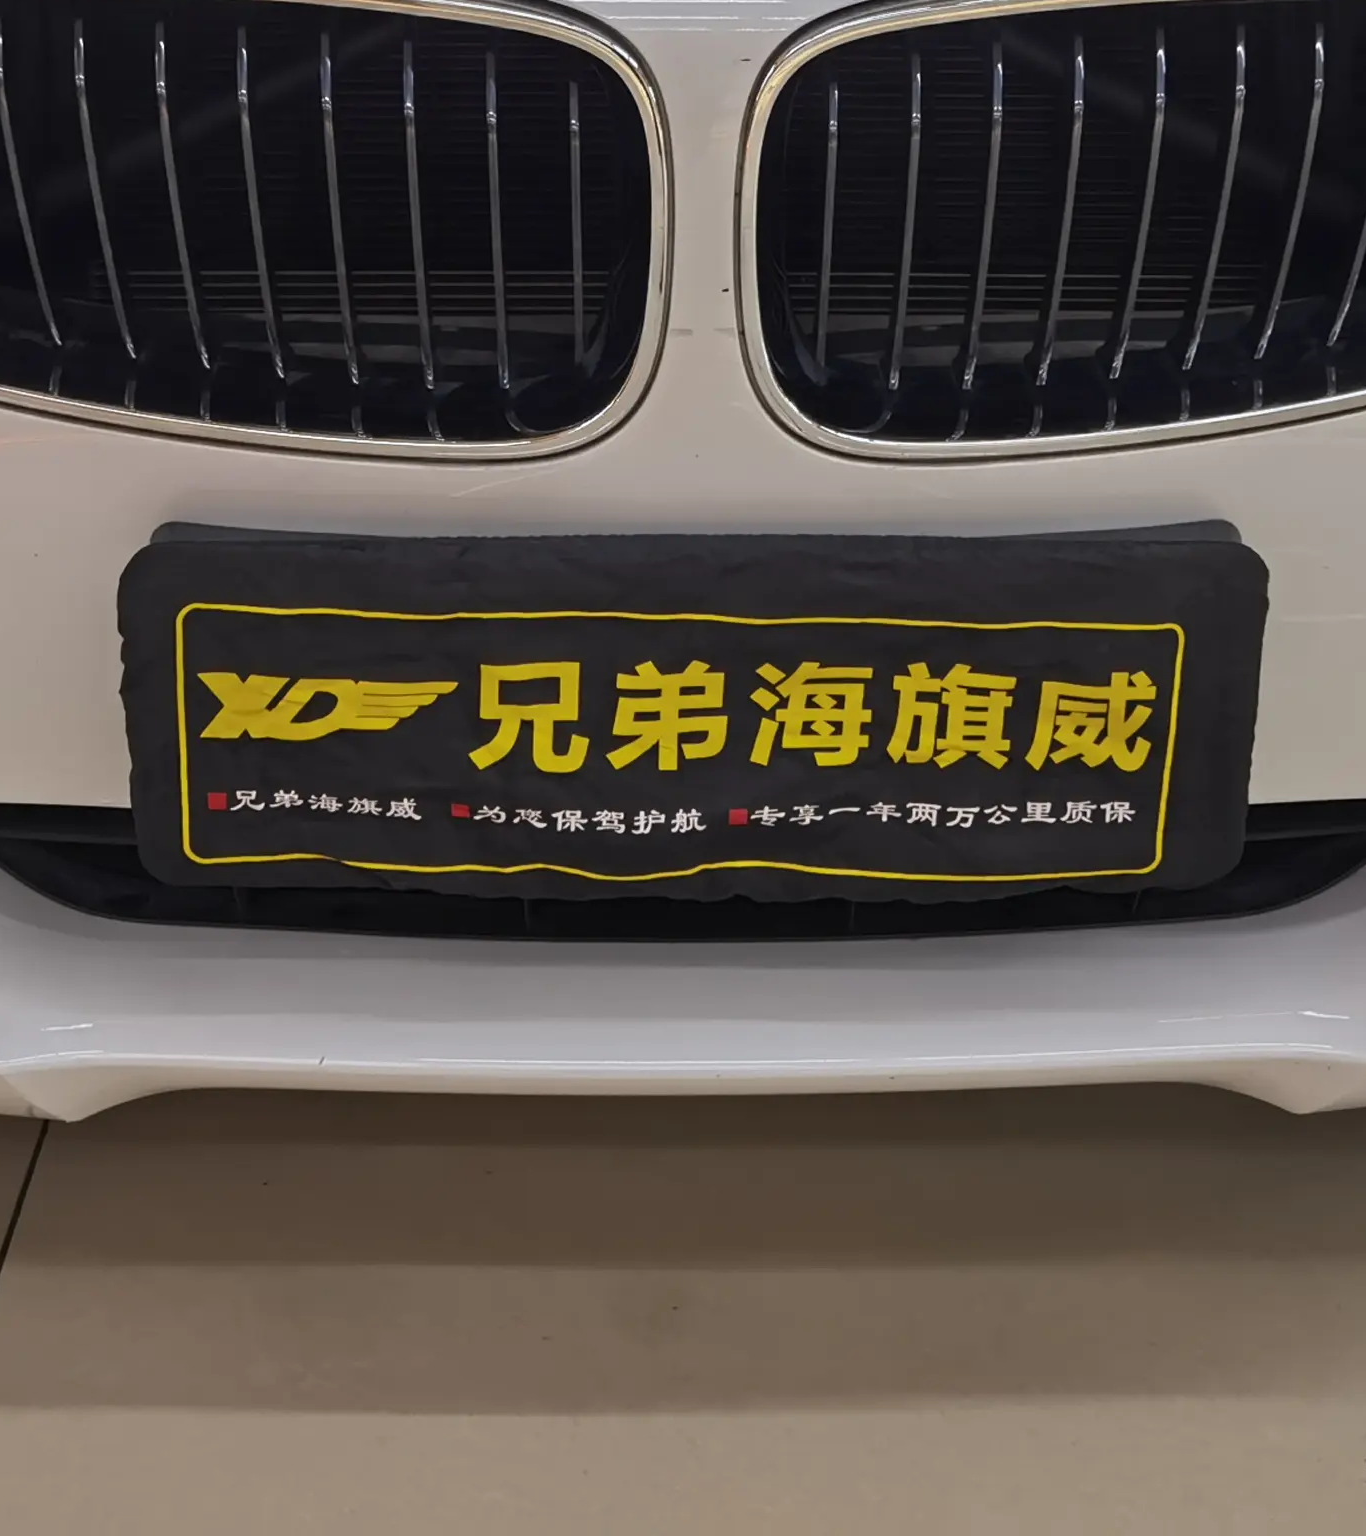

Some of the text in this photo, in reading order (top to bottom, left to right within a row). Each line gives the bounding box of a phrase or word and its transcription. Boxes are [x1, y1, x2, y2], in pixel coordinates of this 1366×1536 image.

[469, 660, 1158, 772] 兄弟海旗威
[230, 789, 1137, 835] 兄弟海旗威 为您保驾护航 专享一年两万公里质保
